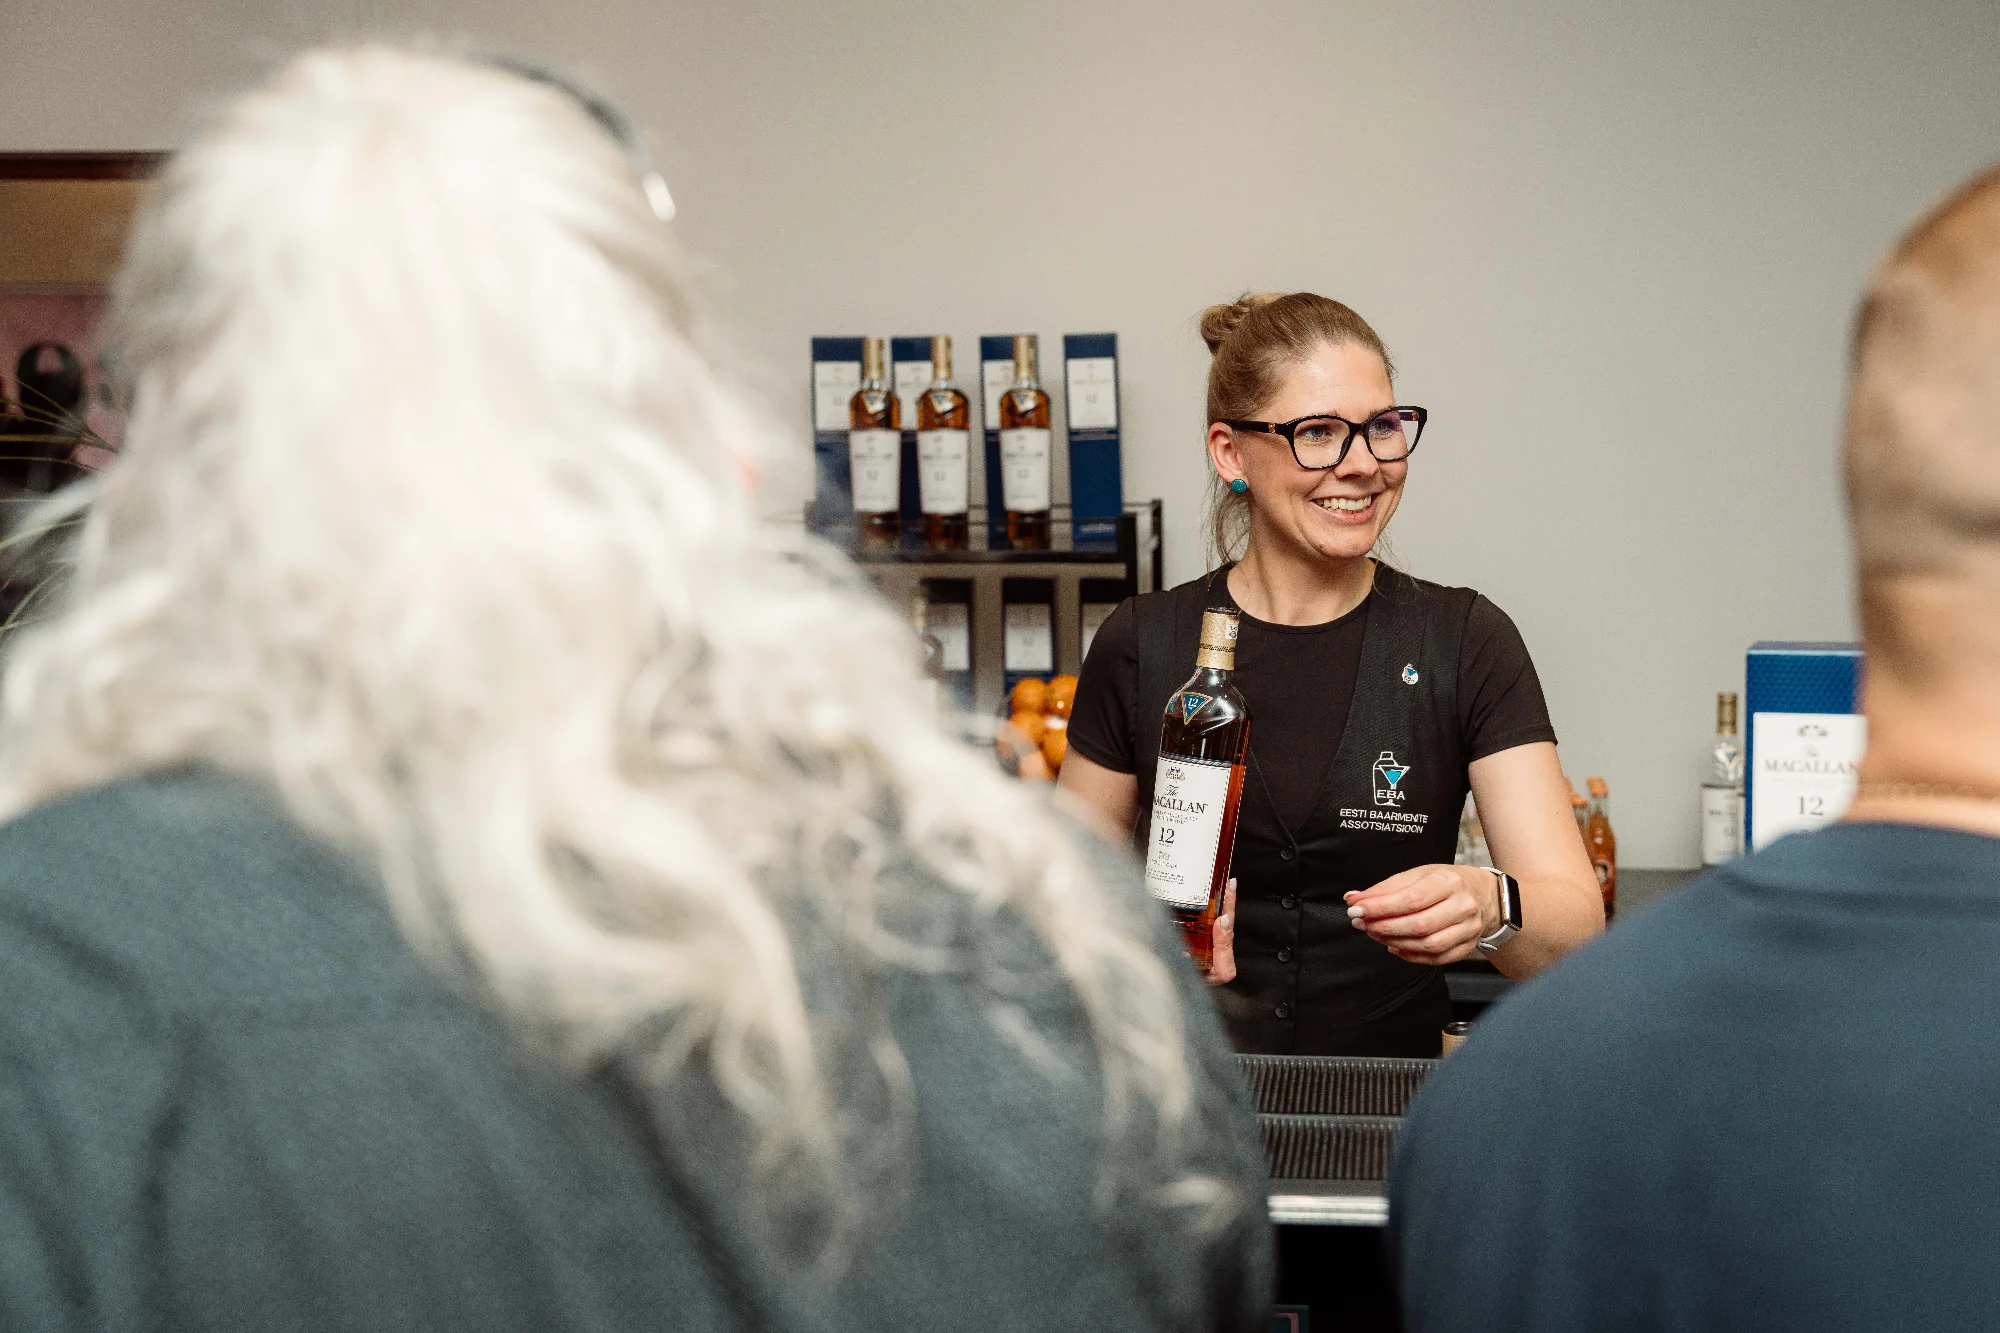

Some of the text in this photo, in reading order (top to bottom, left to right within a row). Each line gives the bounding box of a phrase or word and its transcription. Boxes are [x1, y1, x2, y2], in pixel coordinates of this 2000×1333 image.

[1377, 789, 1406, 801] EBA
[1797, 795, 1825, 816] 12
[1340, 808, 1429, 824] EESTI BAARMENTE
[1339, 819, 1424, 834] ASSOTSIATSIOON
[1158, 826, 1175, 845] 12
